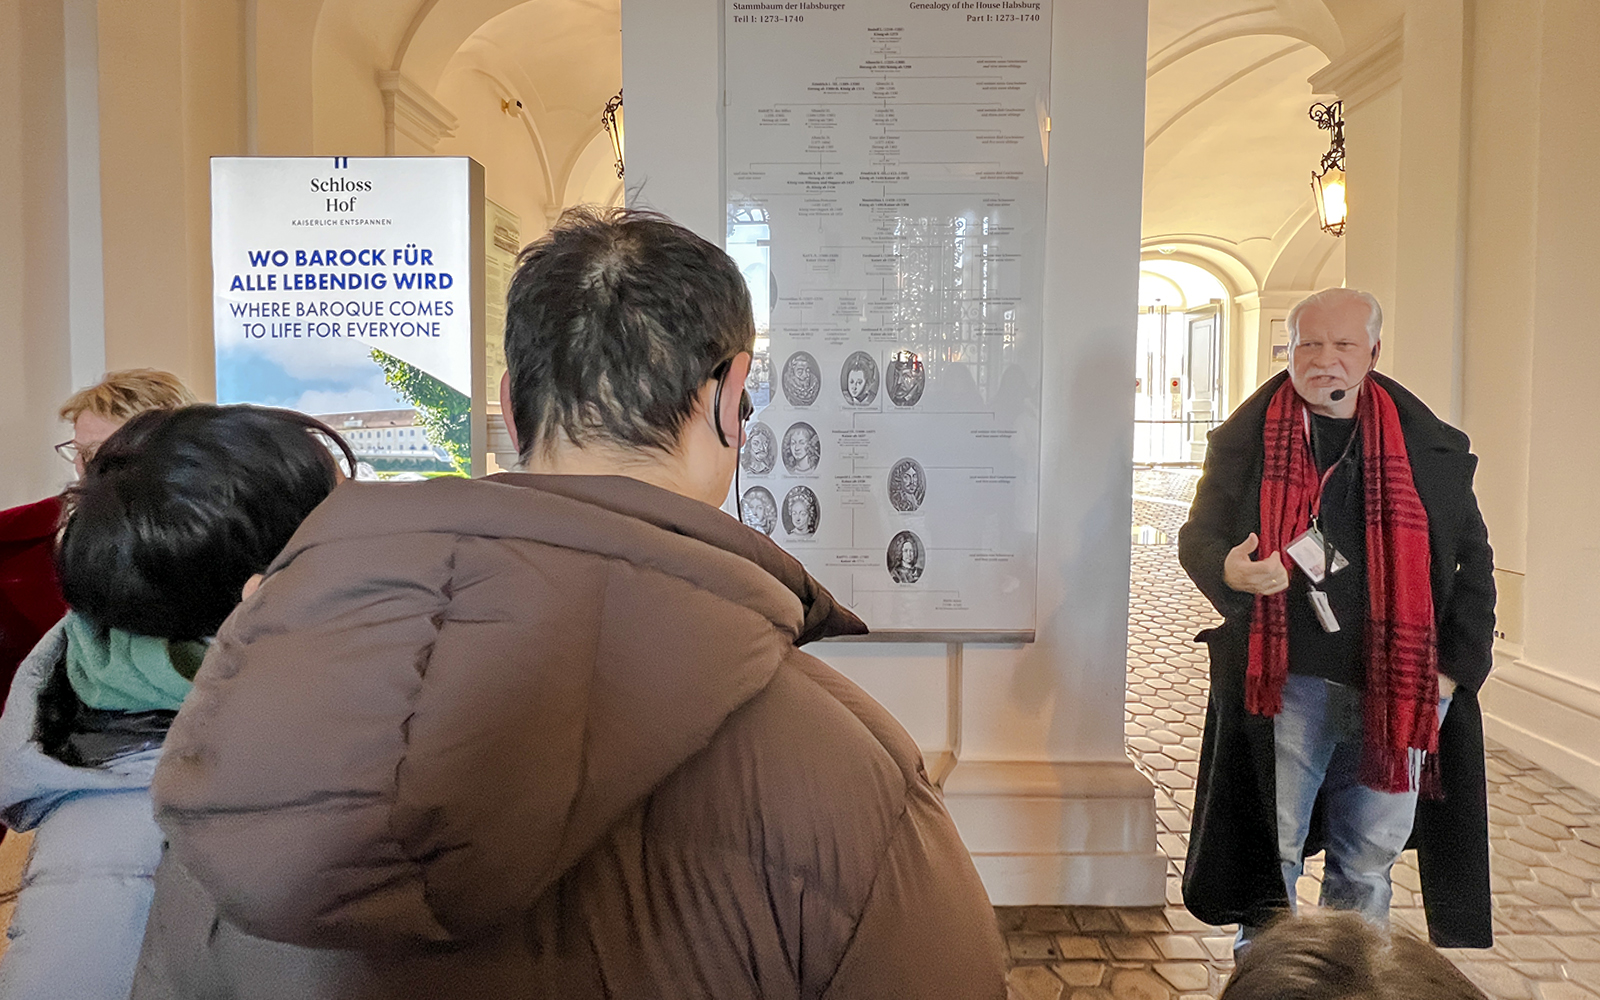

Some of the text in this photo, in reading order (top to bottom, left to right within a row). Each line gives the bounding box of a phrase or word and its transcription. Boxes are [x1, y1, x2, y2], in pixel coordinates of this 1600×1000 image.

[733, 2, 846, 12] Stammbaum der Habsburger
[909, 1, 1041, 11] Genealogy of the House Habsburg
[733, 15, 749, 23] Teil
[751, 15, 757, 23] I:
[966, 14, 984, 22] Part
[986, 14, 993, 22] I:
[310, 177, 372, 192] Schloss
[326, 197, 357, 212] Hof
[291, 218, 392, 227] KAISERLICH ENTSPANNEN
[248, 243, 434, 267] WO BAROCK FÜR
[229, 272, 454, 291] ALLE LEBENDIG WIRD
[229, 300, 454, 317] WHERE BAROQUE COMES
[243, 321, 441, 338] TO LIFE FOR EVERYONE
